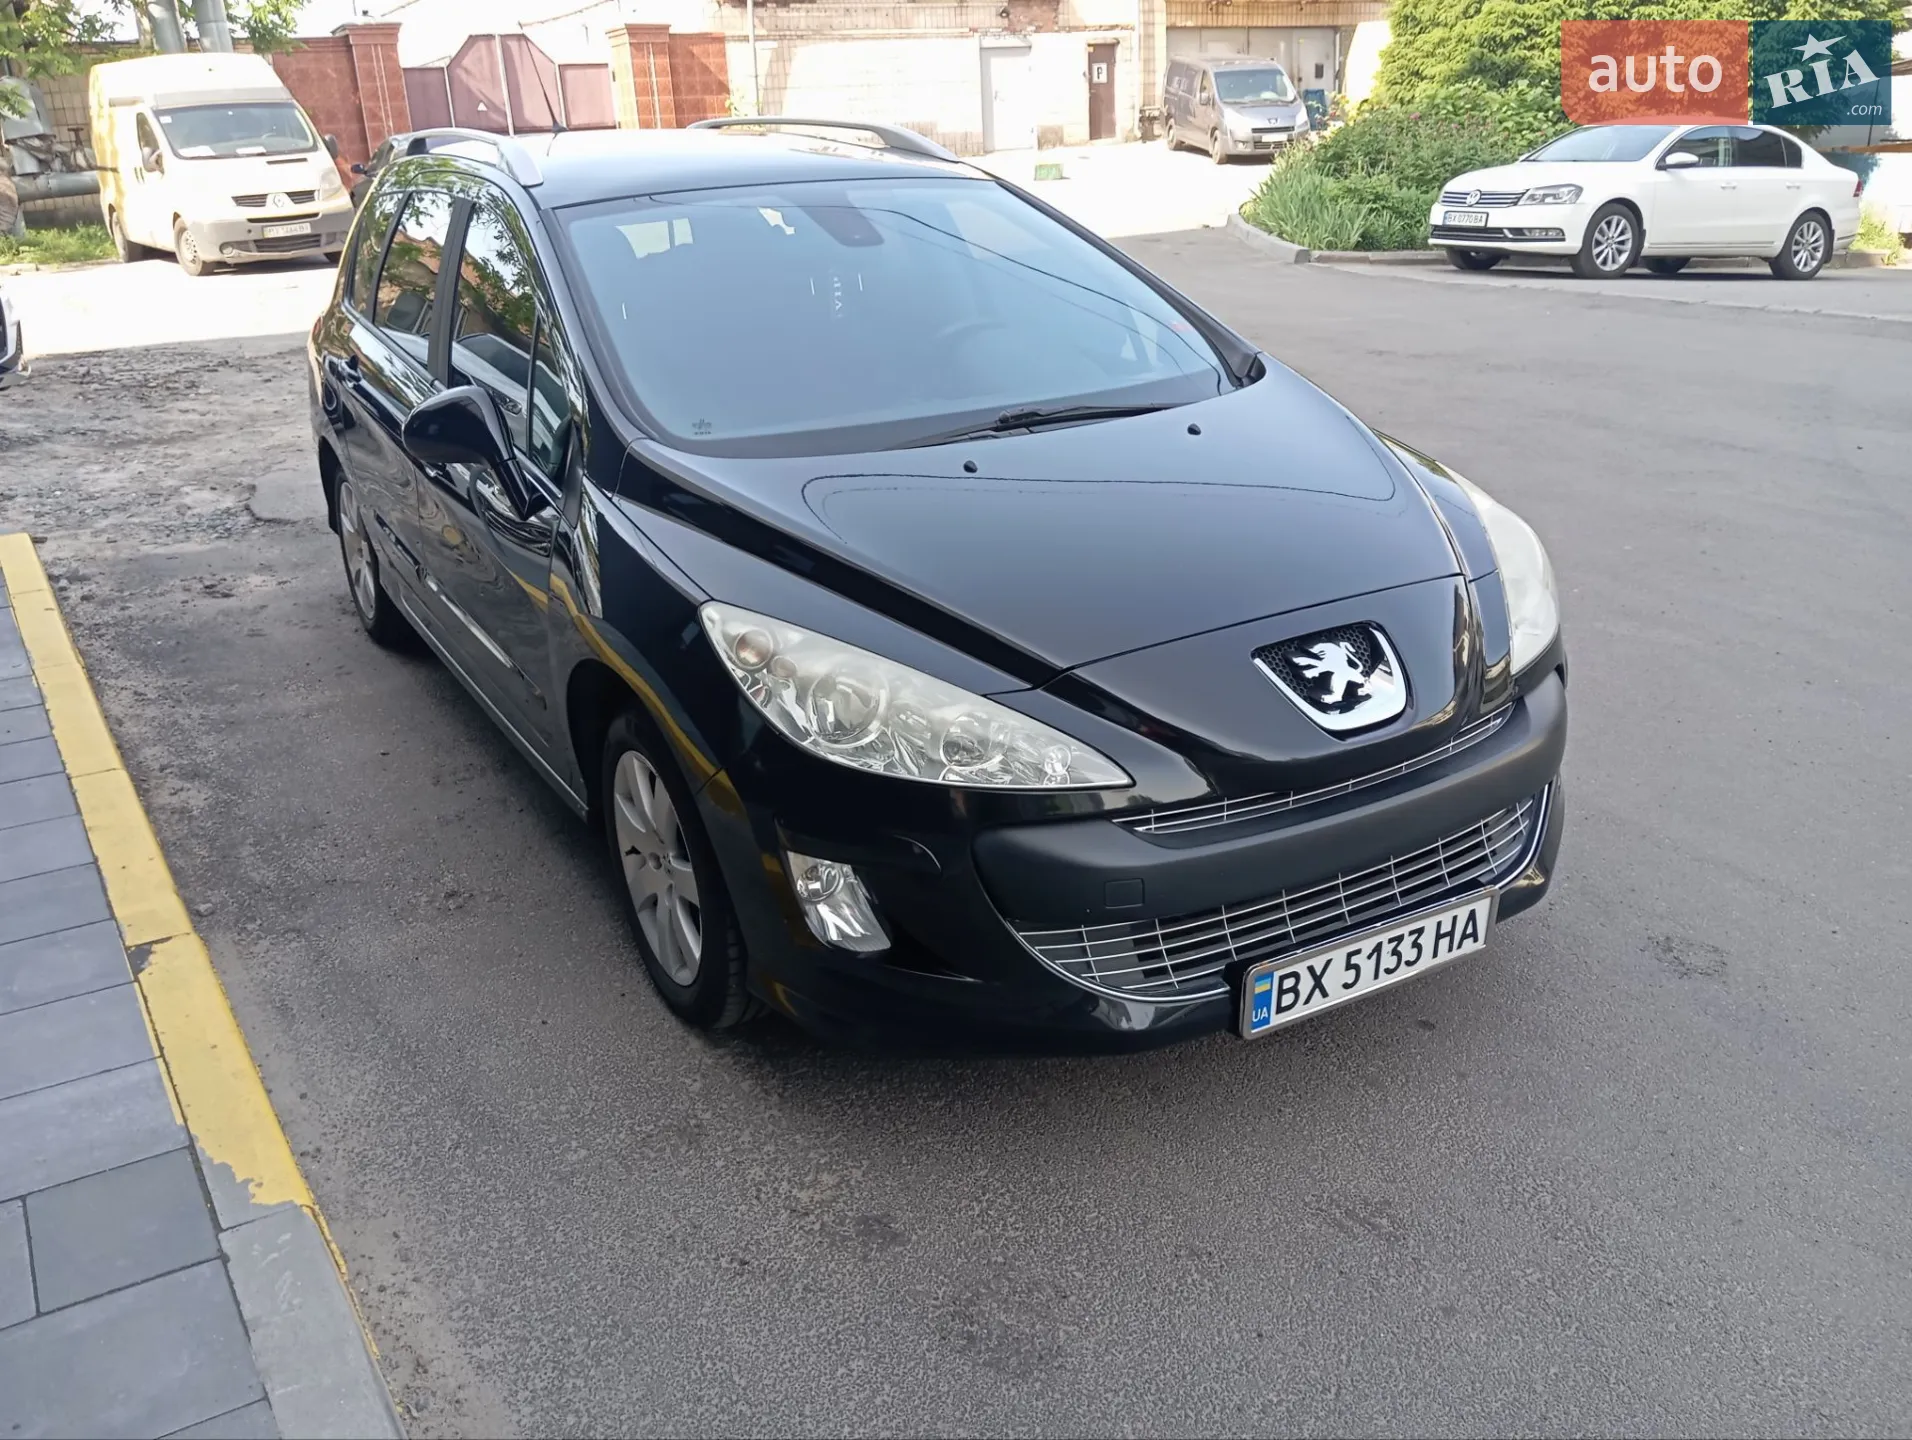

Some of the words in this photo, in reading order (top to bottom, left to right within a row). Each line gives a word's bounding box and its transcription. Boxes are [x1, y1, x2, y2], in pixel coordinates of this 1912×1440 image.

[1275, 958, 1333, 1015] BX
[1342, 926, 1425, 990] 5133
[1432, 908, 1479, 959] HA
[1252, 1009, 1268, 1023] UA
